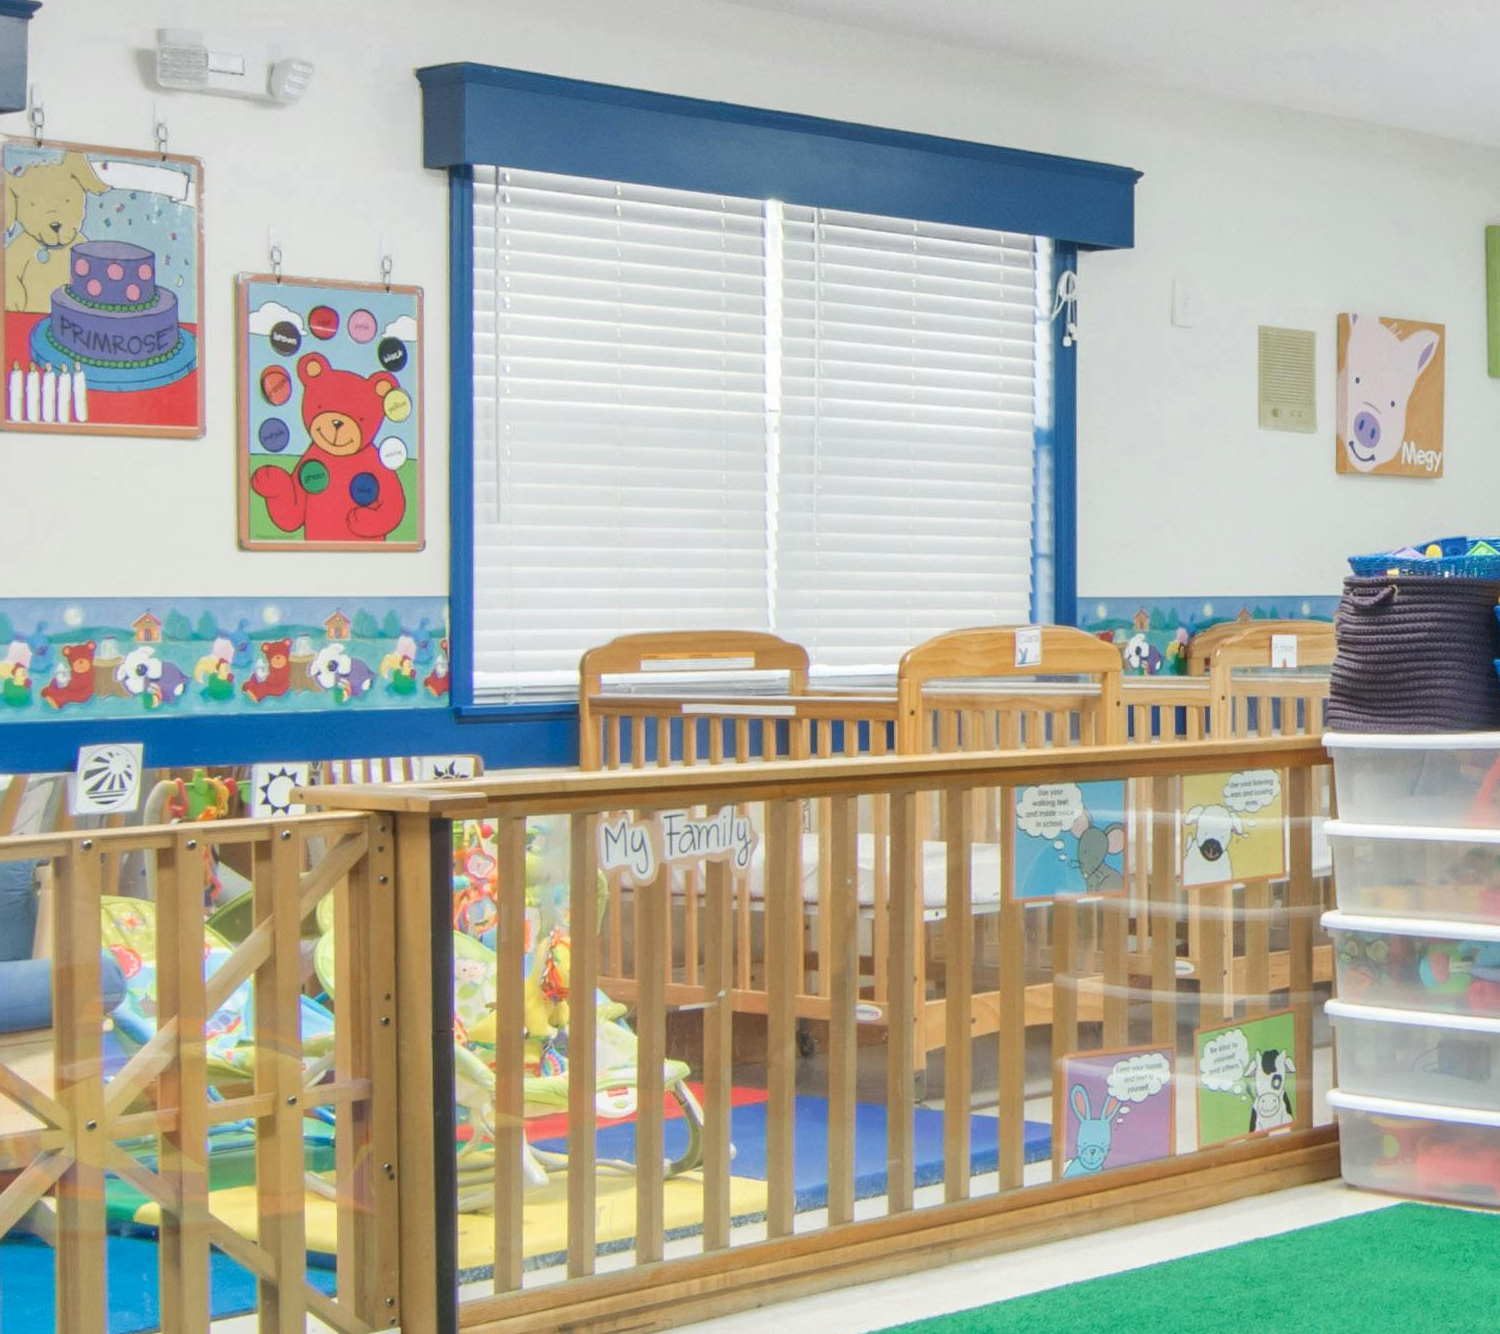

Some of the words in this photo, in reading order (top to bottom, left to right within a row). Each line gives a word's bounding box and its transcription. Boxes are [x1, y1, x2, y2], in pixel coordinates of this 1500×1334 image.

[60, 314, 172, 355] PRIMROSE
[1401, 441, 1442, 473] Megy
[604, 821, 650, 875] My
[663, 804, 753, 867] Family
